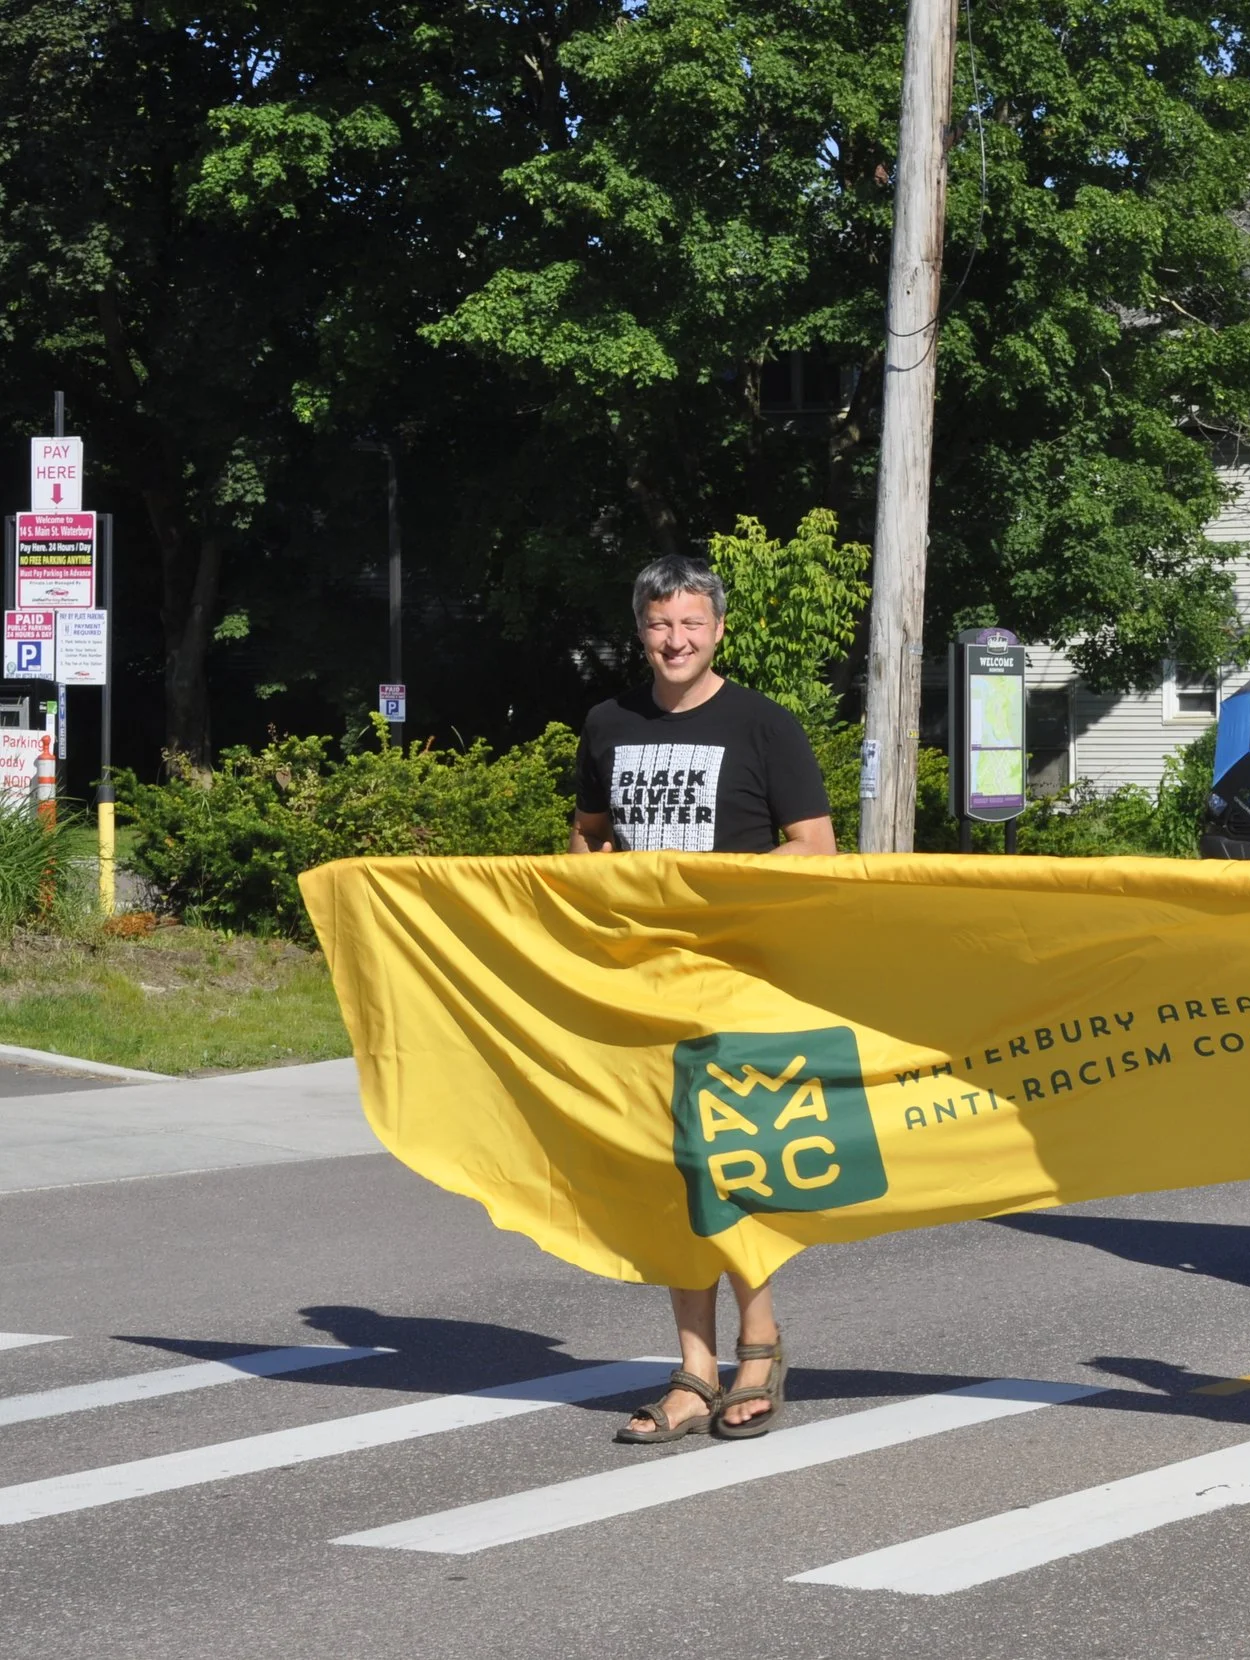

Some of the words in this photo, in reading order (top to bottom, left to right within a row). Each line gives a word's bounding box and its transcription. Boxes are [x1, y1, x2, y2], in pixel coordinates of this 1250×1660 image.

[43, 445, 70, 459] PAY
[37, 466, 76, 479] HERE
[36, 516, 64, 524] Welcome
[66, 516, 74, 524] to
[35, 526, 50, 536] Main
[61, 525, 92, 539] Waterbury
[20, 543, 31, 554] Pay
[49, 543, 56, 551] 24
[57, 543, 75, 552] Hours
[79, 543, 91, 553] Day
[20, 556, 28, 565] NO
[29, 556, 42, 565] FREE
[43, 556, 66, 565] PARKING
[67, 555, 91, 565] ANYTIME
[44, 569, 62, 578] Parking
[15, 614, 44, 625] PAID
[21, 645, 37, 669] P
[980, 657, 1014, 667] WELCOME
[3, 735, 44, 752] Parking
[619, 770, 706, 787] BLACK
[622, 788, 696, 805] LIVES
[904, 1043, 1171, 1130] ANTI-RACISM
